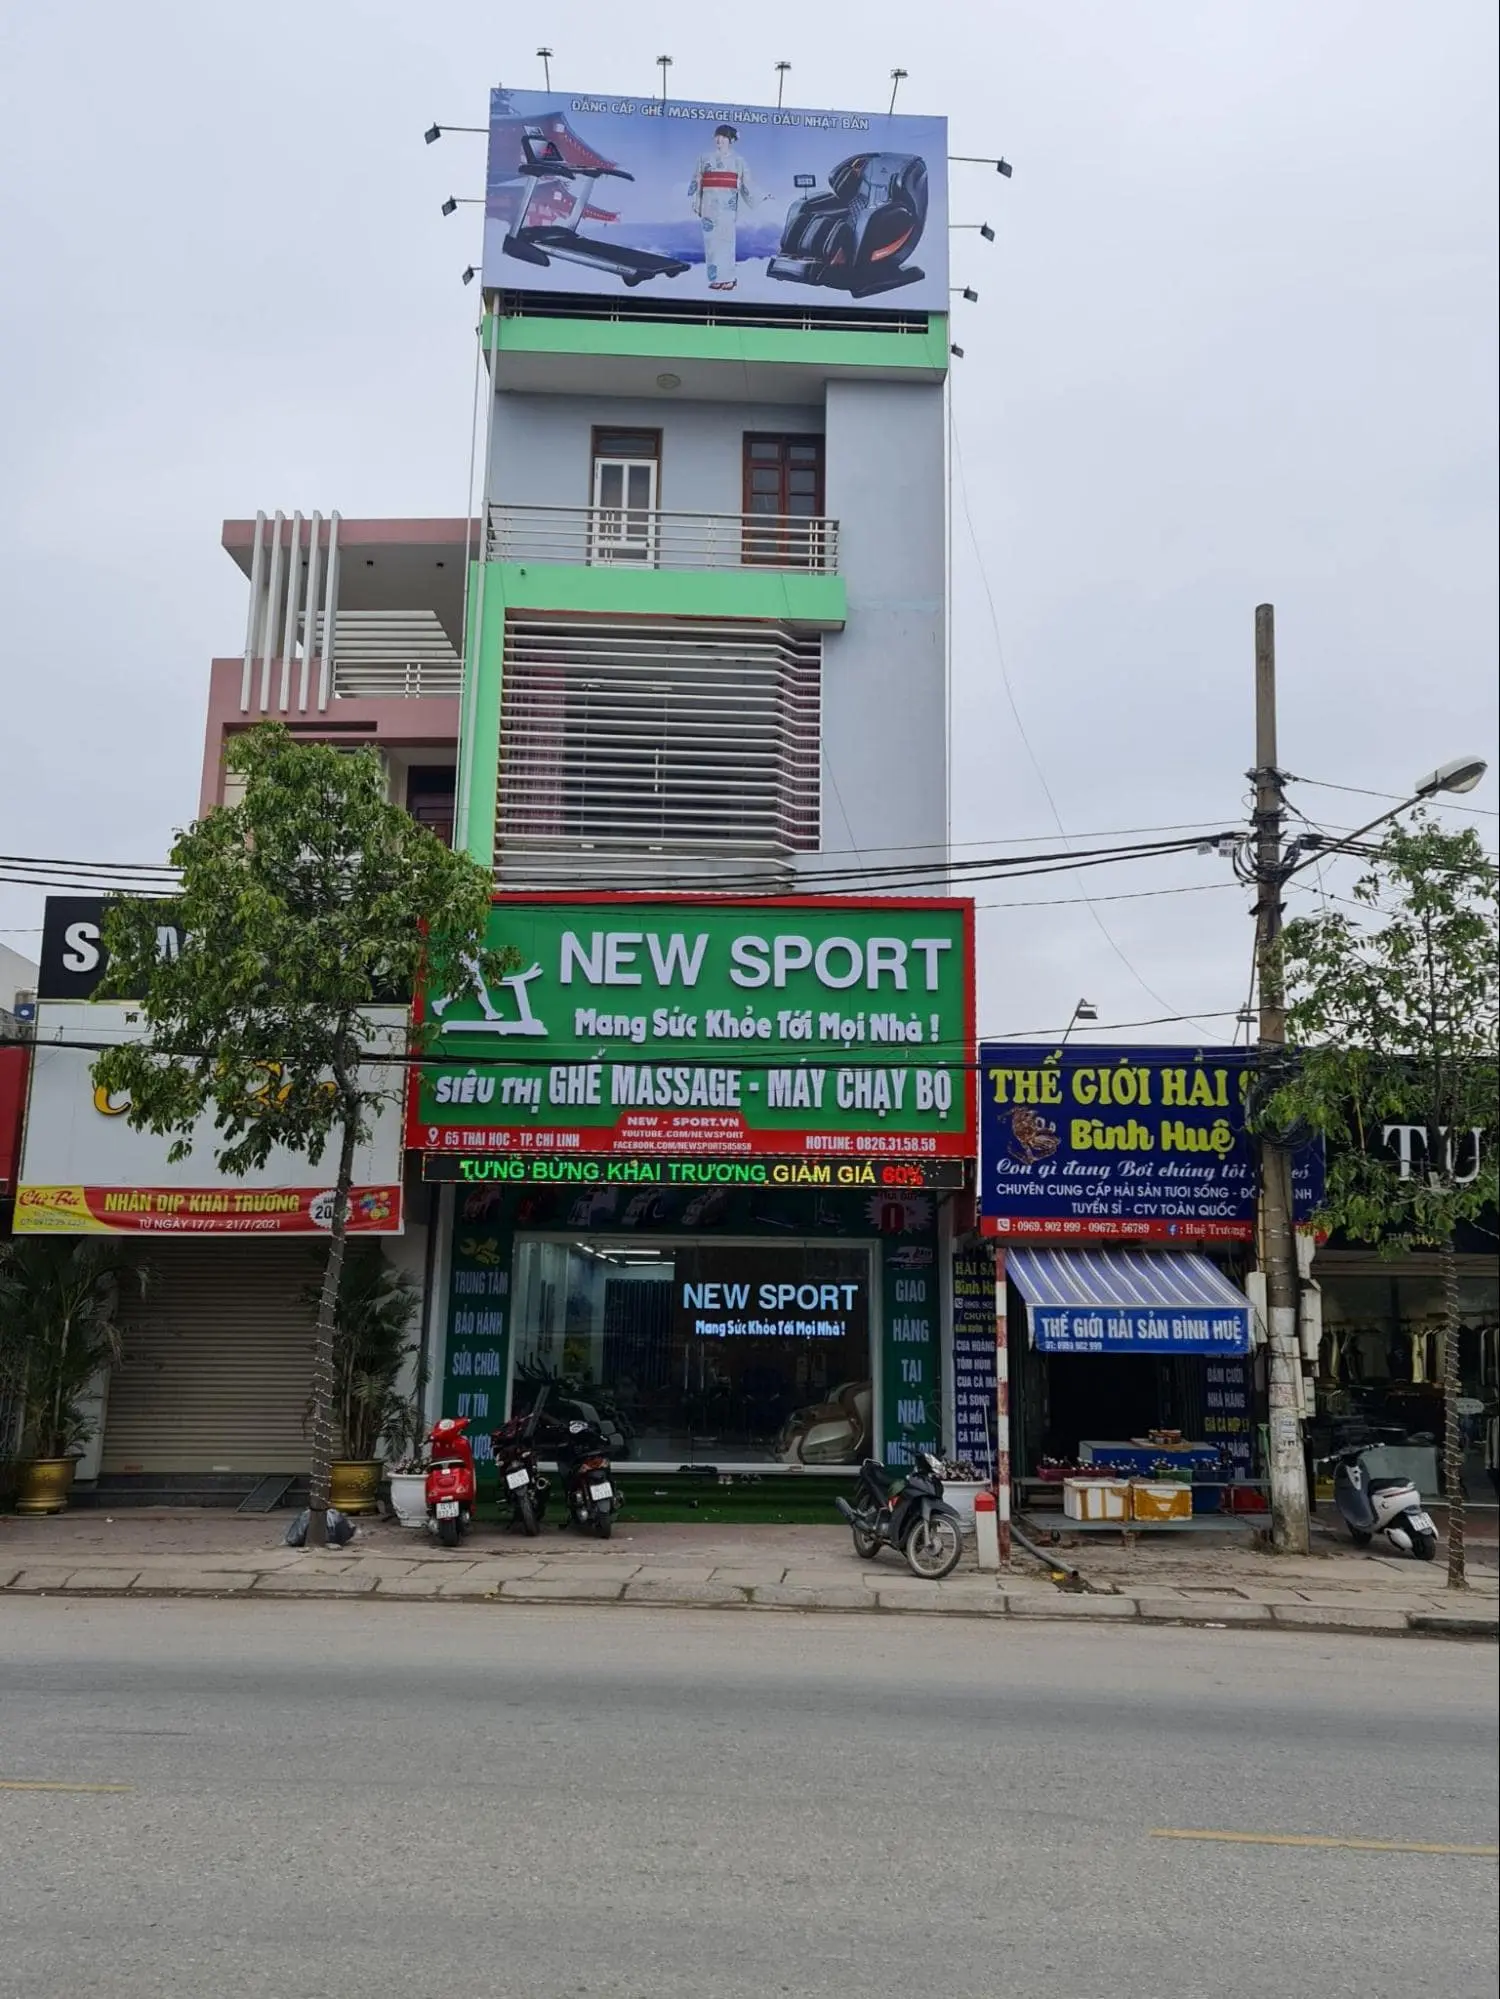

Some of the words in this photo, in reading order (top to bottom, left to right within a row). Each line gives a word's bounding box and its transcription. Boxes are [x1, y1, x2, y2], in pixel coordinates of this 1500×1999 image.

[668, 106, 730, 121] MASSAGE
[560, 931, 709, 986] NEW
[729, 935, 952, 991] SPORT
[575, 1008, 646, 1043] Mang
[653, 1006, 698, 1038] Sức
[705, 1004, 771, 1040] Khỏe
[777, 1009, 812, 1041] Tới
[819, 1012, 865, 1048] Mọi
[870, 1012, 922, 1042] Nhà
[436, 1069, 495, 1104] SIÊU
[501, 1077, 542, 1114] THỊ
[549, 1048, 606, 1105] GHẾ
[611, 1064, 741, 1107] MASSAGE
[767, 1058, 826, 1108] MÁY
[836, 1068, 906, 1117] CHẠY
[916, 1062, 952, 1119] BỘ
[989, 1049, 1063, 1105] THẾ
[1072, 1057, 1151, 1105] GIỚI
[1160, 1047, 1229, 1107] HẢI
[621, 1129, 744, 1139] YOUTUBE.COM/NEWSPORT
[627, 1117, 658, 1126] NEW
[672, 1117, 739, 1127] SPORT.VN
[445, 1131, 459, 1145] 65
[556, 1133, 580, 1147] LINH
[806, 1136, 853, 1150] HOTLINE:
[856, 1137, 937, 1151] 0826.31.58.58
[1070, 1118, 1154, 1151] Bình
[1161, 1118, 1235, 1160] Huệ
[607, 1163, 661, 1181] KHAI
[837, 1161, 876, 1183] GIÁ
[996, 1158, 1033, 1175] Con
[1038, 1161, 1057, 1178] gì
[1062, 1160, 1111, 1179] đang
[1117, 1160, 1154, 1177] Bơi
[1158, 1161, 1215, 1181] chúng
[1221, 1163, 1247, 1178] tôi
[996, 1181, 1044, 1195] CHUYÊN
[1047, 1184, 1083, 1196] CUNG
[1085, 1182, 1111, 1196] CẤP
[1114, 1182, 1134, 1197] HẢI
[1137, 1181, 1161, 1197] SẢN
[1193, 1183, 1229, 1198] SỐNG
[104, 1190, 151, 1212] NHÂN
[156, 1194, 185, 1215] DỊP
[189, 1194, 228, 1212] KHAI
[233, 1192, 300, 1212] TRƯƠNG
[1072, 1199, 1108, 1214] TUYỂN
[1133, 1204, 1158, 1214] CTV
[1160, 1201, 1195, 1215] TOÀN
[1198, 1201, 1236, 1216] QUỐC
[154, 1217, 187, 1229] NGÀY
[191, 1219, 214, 1230] 17/7
[226, 1219, 281, 1230] 21/7/2021
[1044, 1222, 1061, 1232] 902
[1064, 1222, 1080, 1232] 999
[1121, 1223, 1150, 1233] 56789
[455, 1270, 486, 1294] TRUNG
[895, 1279, 926, 1302] GIAO
[683, 1283, 750, 1309] NEW
[758, 1284, 859, 1311] SPORT
[455, 1303, 475, 1335] BẢO
[695, 1320, 726, 1337] Mang
[728, 1319, 746, 1335] Sức
[748, 1318, 777, 1335] Khỏe
[778, 1320, 794, 1336] Tới
[796, 1320, 815, 1340] Mọi
[892, 1314, 930, 1343] HÀNG
[1040, 1310, 1069, 1338] THẾ
[1073, 1311, 1103, 1338] GIỚI
[1108, 1310, 1133, 1338] HẢI
[1137, 1310, 1169, 1339] SẢN
[1172, 1315, 1209, 1340] BÌNH
[1212, 1315, 1242, 1344] HUỆ
[452, 1344, 472, 1376] SỬA
[901, 1359, 922, 1388] TẠI
[457, 1393, 471, 1417] UY
[473, 1388, 489, 1417] TÍN
[897, 1394, 926, 1424] NHÀ
